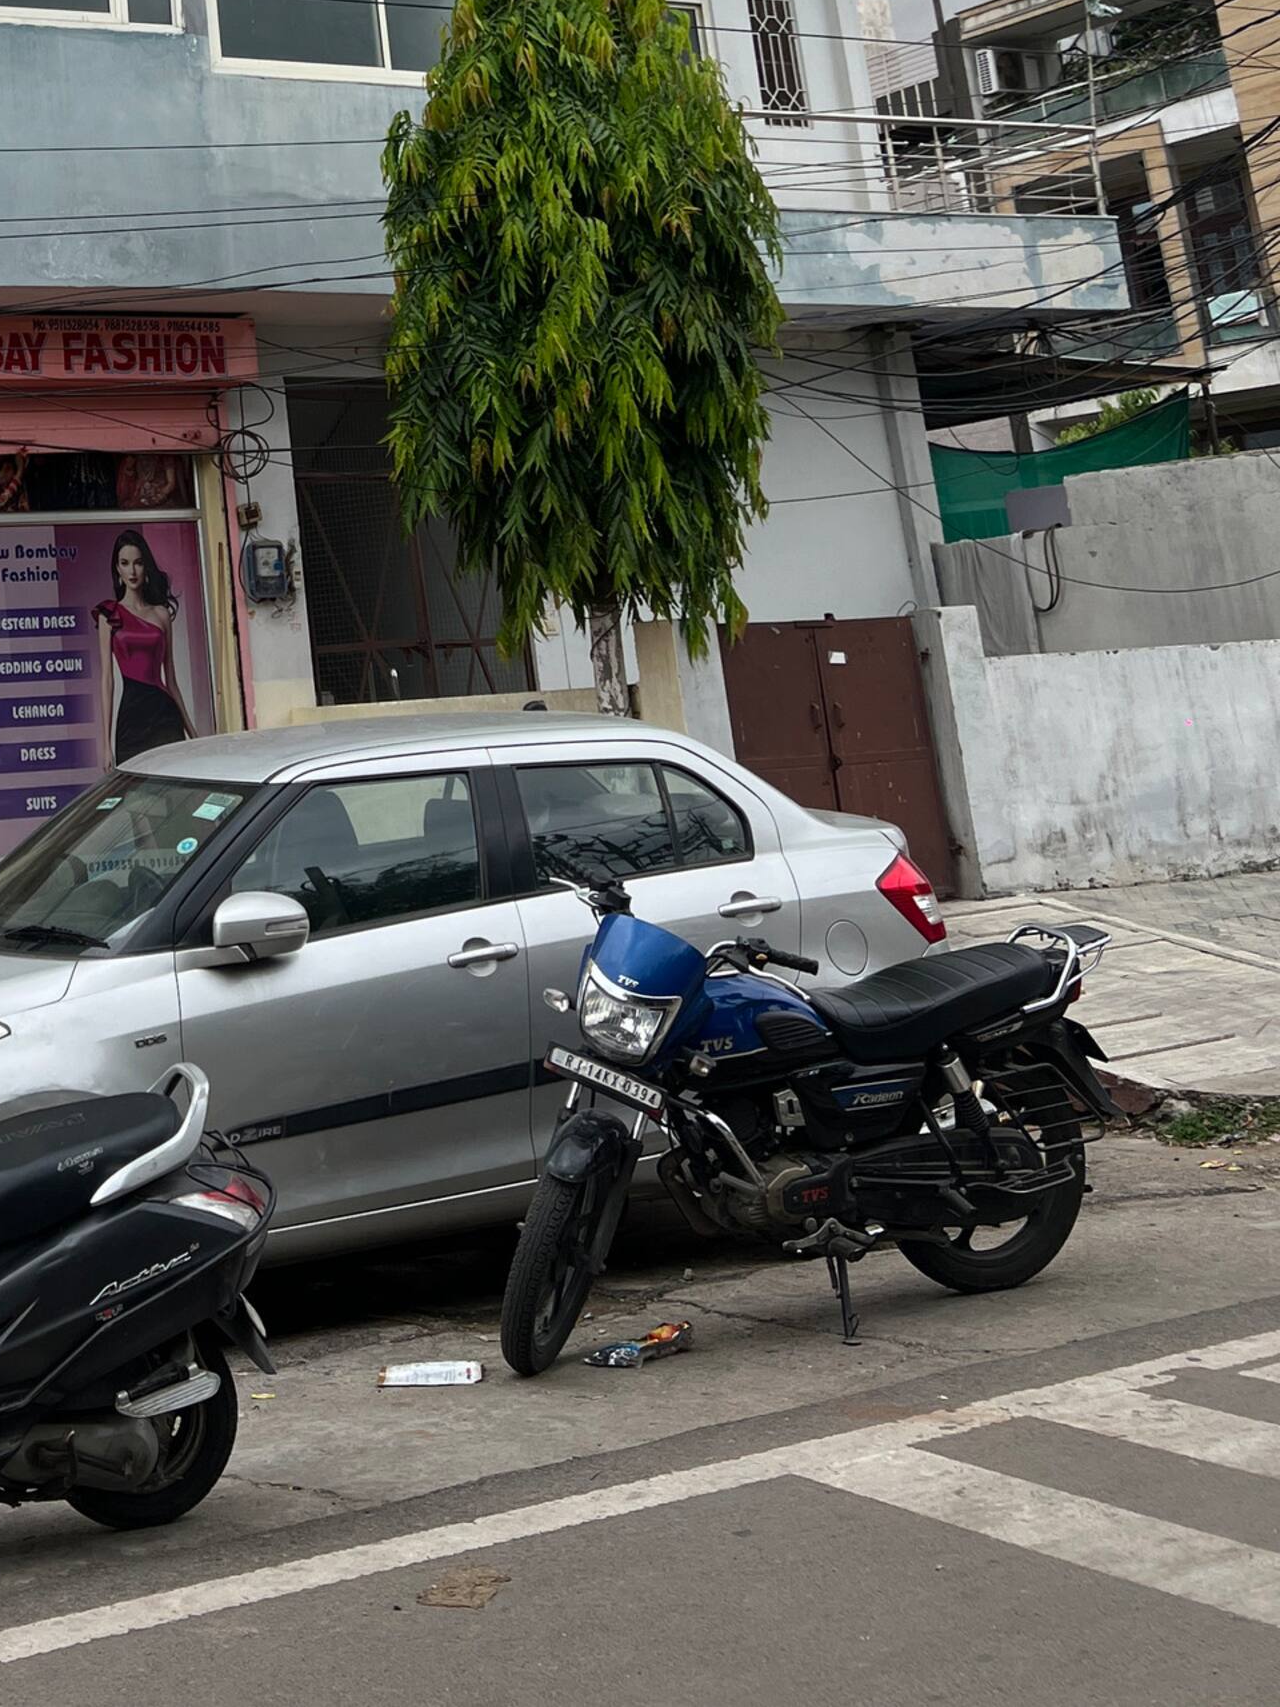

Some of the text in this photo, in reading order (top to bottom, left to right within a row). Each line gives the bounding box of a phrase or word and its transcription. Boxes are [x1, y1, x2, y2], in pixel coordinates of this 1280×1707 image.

[62, 332, 230, 379] FASHION
[14, 544, 77, 562] Bombay
[1, 566, 59, 583] Fashion
[43, 615, 76, 629] DRESS
[46, 658, 83, 672] GOWN
[12, 704, 65, 719] LEHANGA
[20, 747, 57, 762] DRESS
[26, 795, 57, 811] SUITS
[700, 1036, 734, 1053] TVS
[852, 1090, 904, 1105] Radeon
[801, 1188, 829, 1204] TVS
[89, 1251, 192, 1306] Activa
